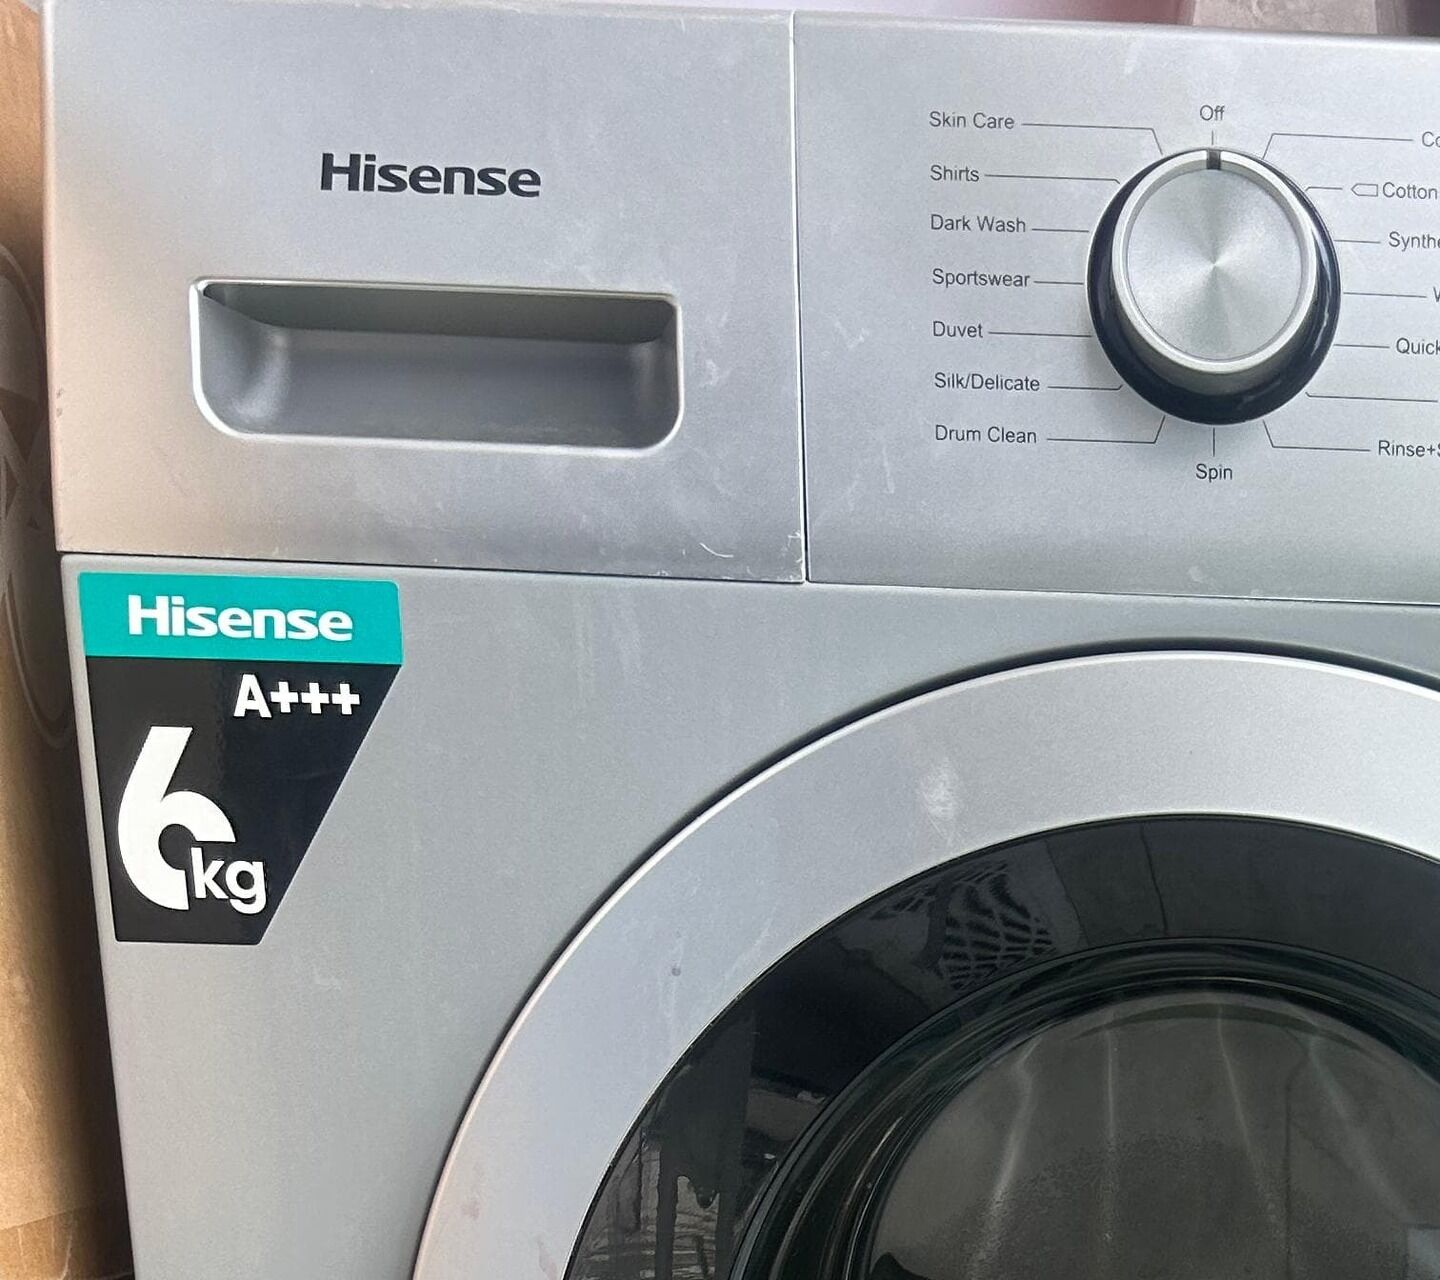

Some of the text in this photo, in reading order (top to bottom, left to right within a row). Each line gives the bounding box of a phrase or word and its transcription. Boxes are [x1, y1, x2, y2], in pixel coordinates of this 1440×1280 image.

[930, 111, 1014, 129] Skin Care
[1200, 105, 1225, 121] Off
[321, 153, 541, 197] Hisense
[930, 165, 979, 182] Shirts
[1383, 182, 1437, 199] Cotton
[931, 214, 1025, 232] Dark Wash
[933, 268, 1030, 288] Sportswear
[933, 321, 983, 338] Duvet
[935, 372, 1039, 391] Silk/Delicate
[936, 425, 1036, 443] Drum Clean
[1196, 463, 1232, 482] Spin
[128, 595, 352, 641] Hisense
[234, 674, 360, 717] A+++
